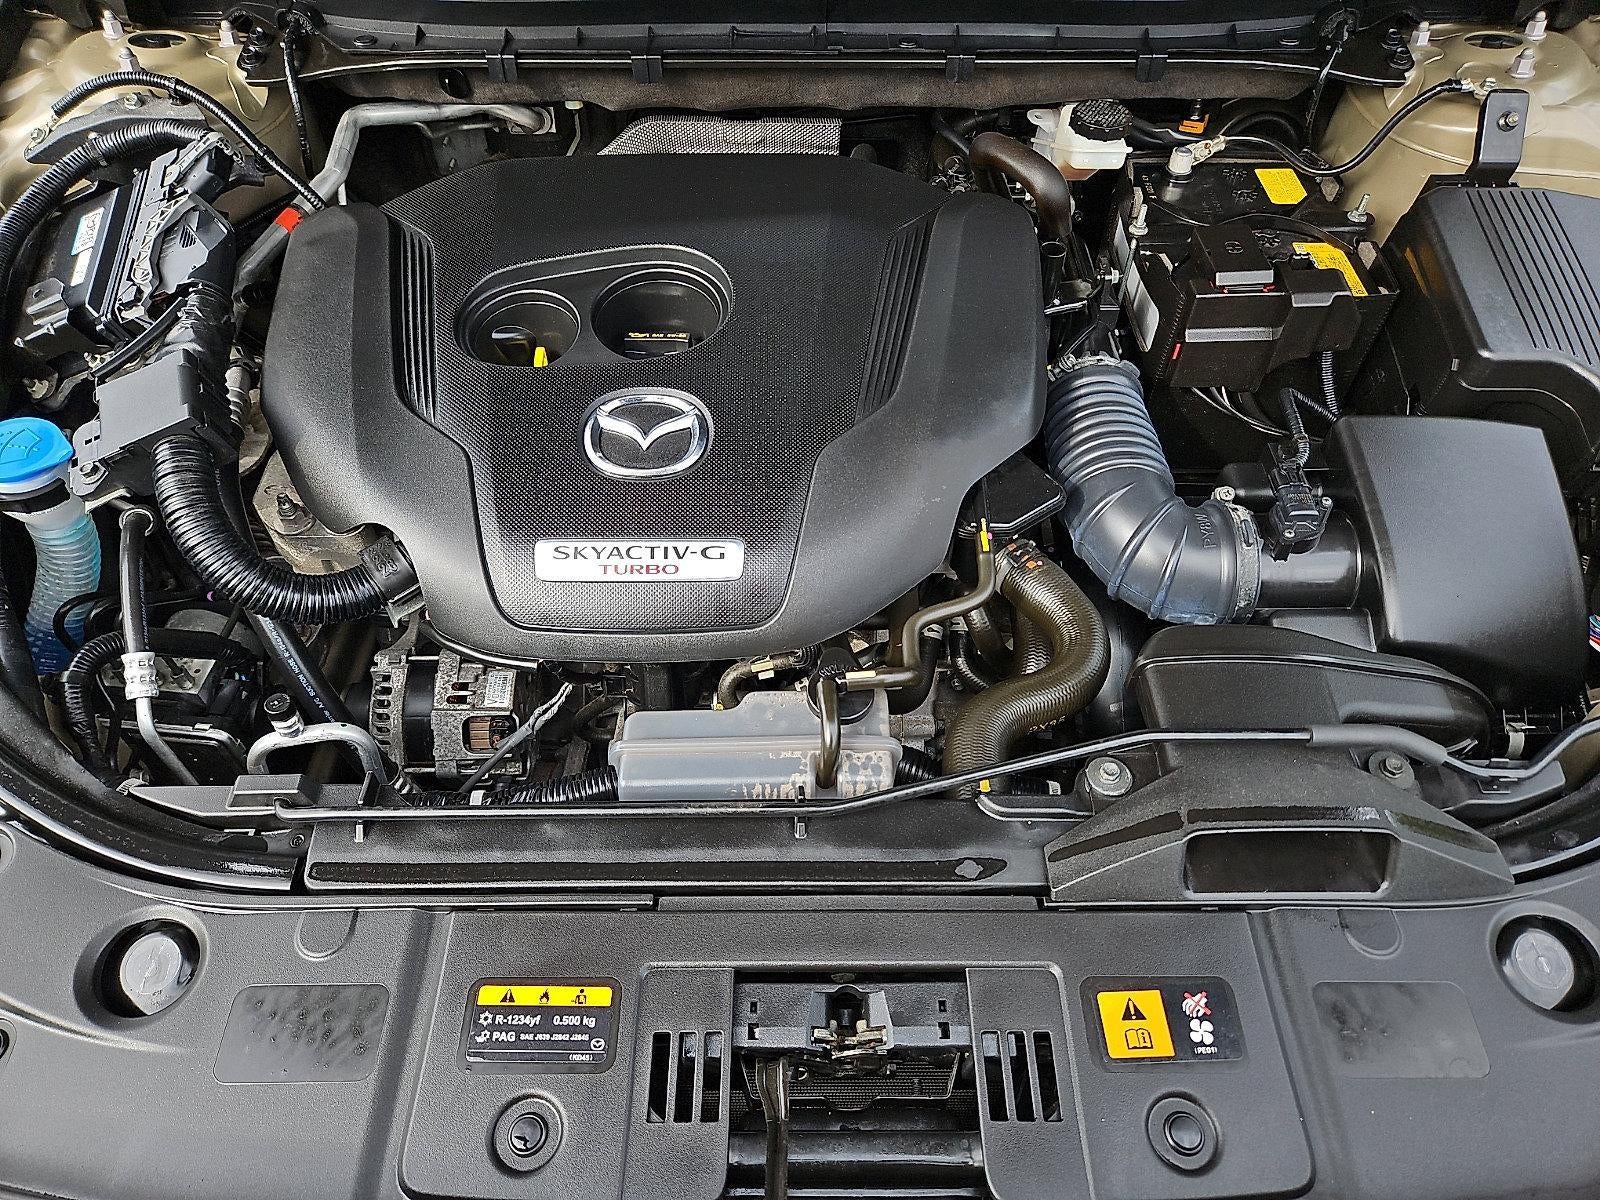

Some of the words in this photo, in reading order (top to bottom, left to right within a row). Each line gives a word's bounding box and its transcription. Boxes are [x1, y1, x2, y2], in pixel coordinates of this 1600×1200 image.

[552, 545, 726, 560] SKYACTIV-G
[598, 564, 680, 575] TURBO
[287, 658, 300, 674] HOSE
[297, 674, 316, 697] SUCTION
[314, 697, 325, 709] A/C
[494, 1014, 541, 1027] R-1234yf
[553, 1015, 580, 1026] 0.500
[582, 1015, 596, 1028] kg
[492, 1031, 516, 1042] PAG
[519, 1033, 534, 1041] SAE
